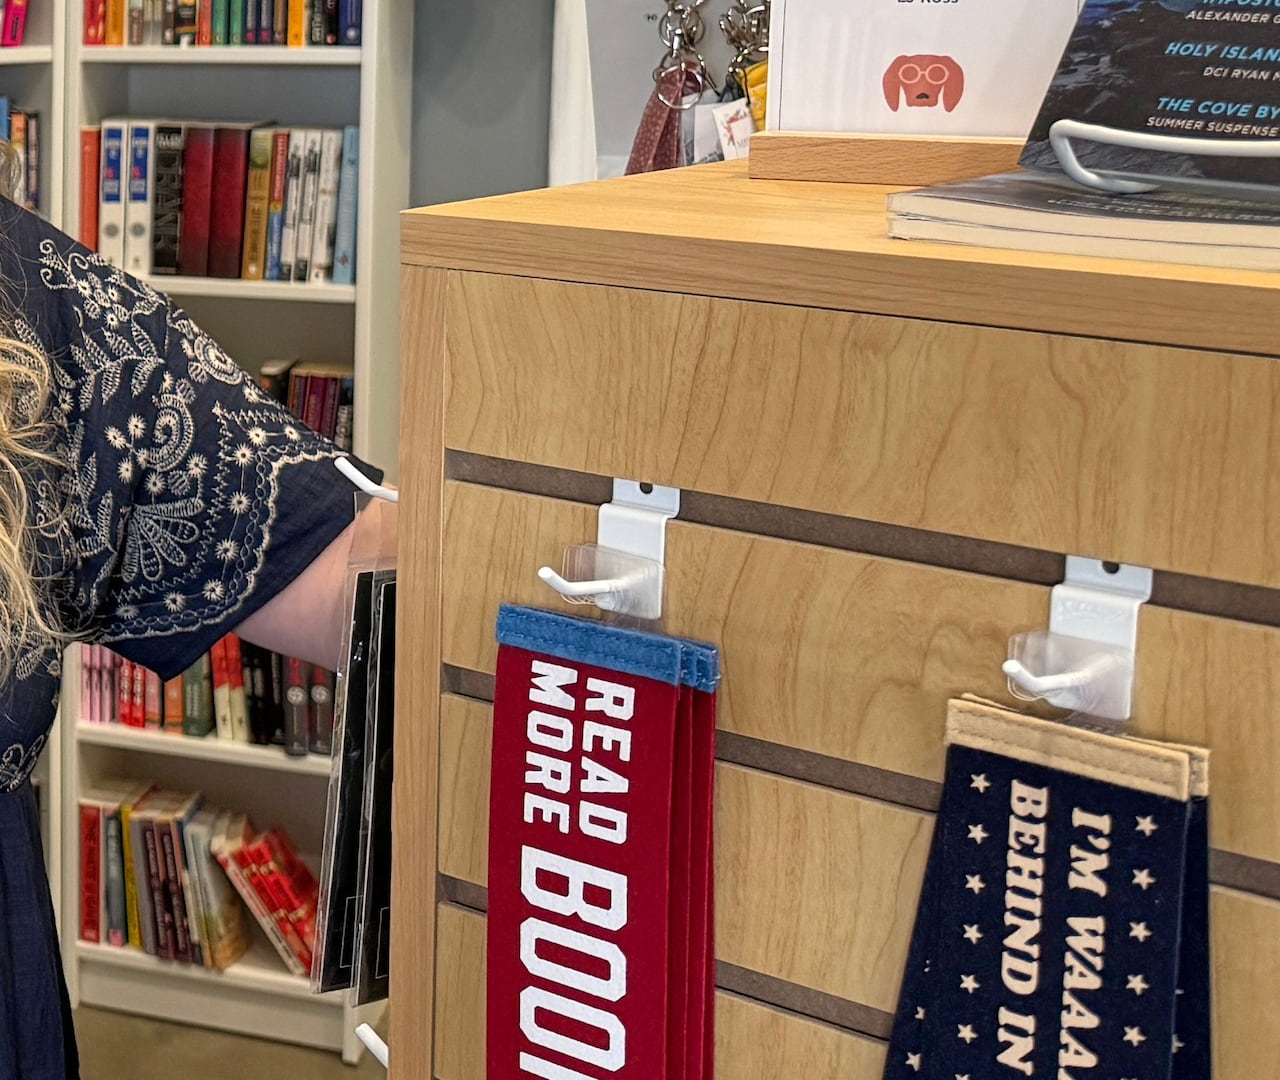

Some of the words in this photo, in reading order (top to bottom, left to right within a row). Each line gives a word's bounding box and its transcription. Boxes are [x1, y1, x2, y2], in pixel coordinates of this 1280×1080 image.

[1186, 11, 1271, 23] ALEXANDER
[1164, 42, 1218, 57] HOLY
[1202, 67, 1228, 77] DCI
[1231, 68, 1269, 80] RYAN
[1146, 116, 1203, 131] SUMMER
[1206, 121, 1278, 137] SUSPENSE
[1156, 98, 1194, 112] THE
[1198, 101, 1252, 118] COVE
[1256, 103, 1280, 120] BY
[522, 659, 580, 834] MORE
[580, 680, 636, 846] READ
[1068, 807, 1114, 897] I'M
[997, 776, 1050, 995] BEHIND
[995, 1007, 1035, 1076] IN
